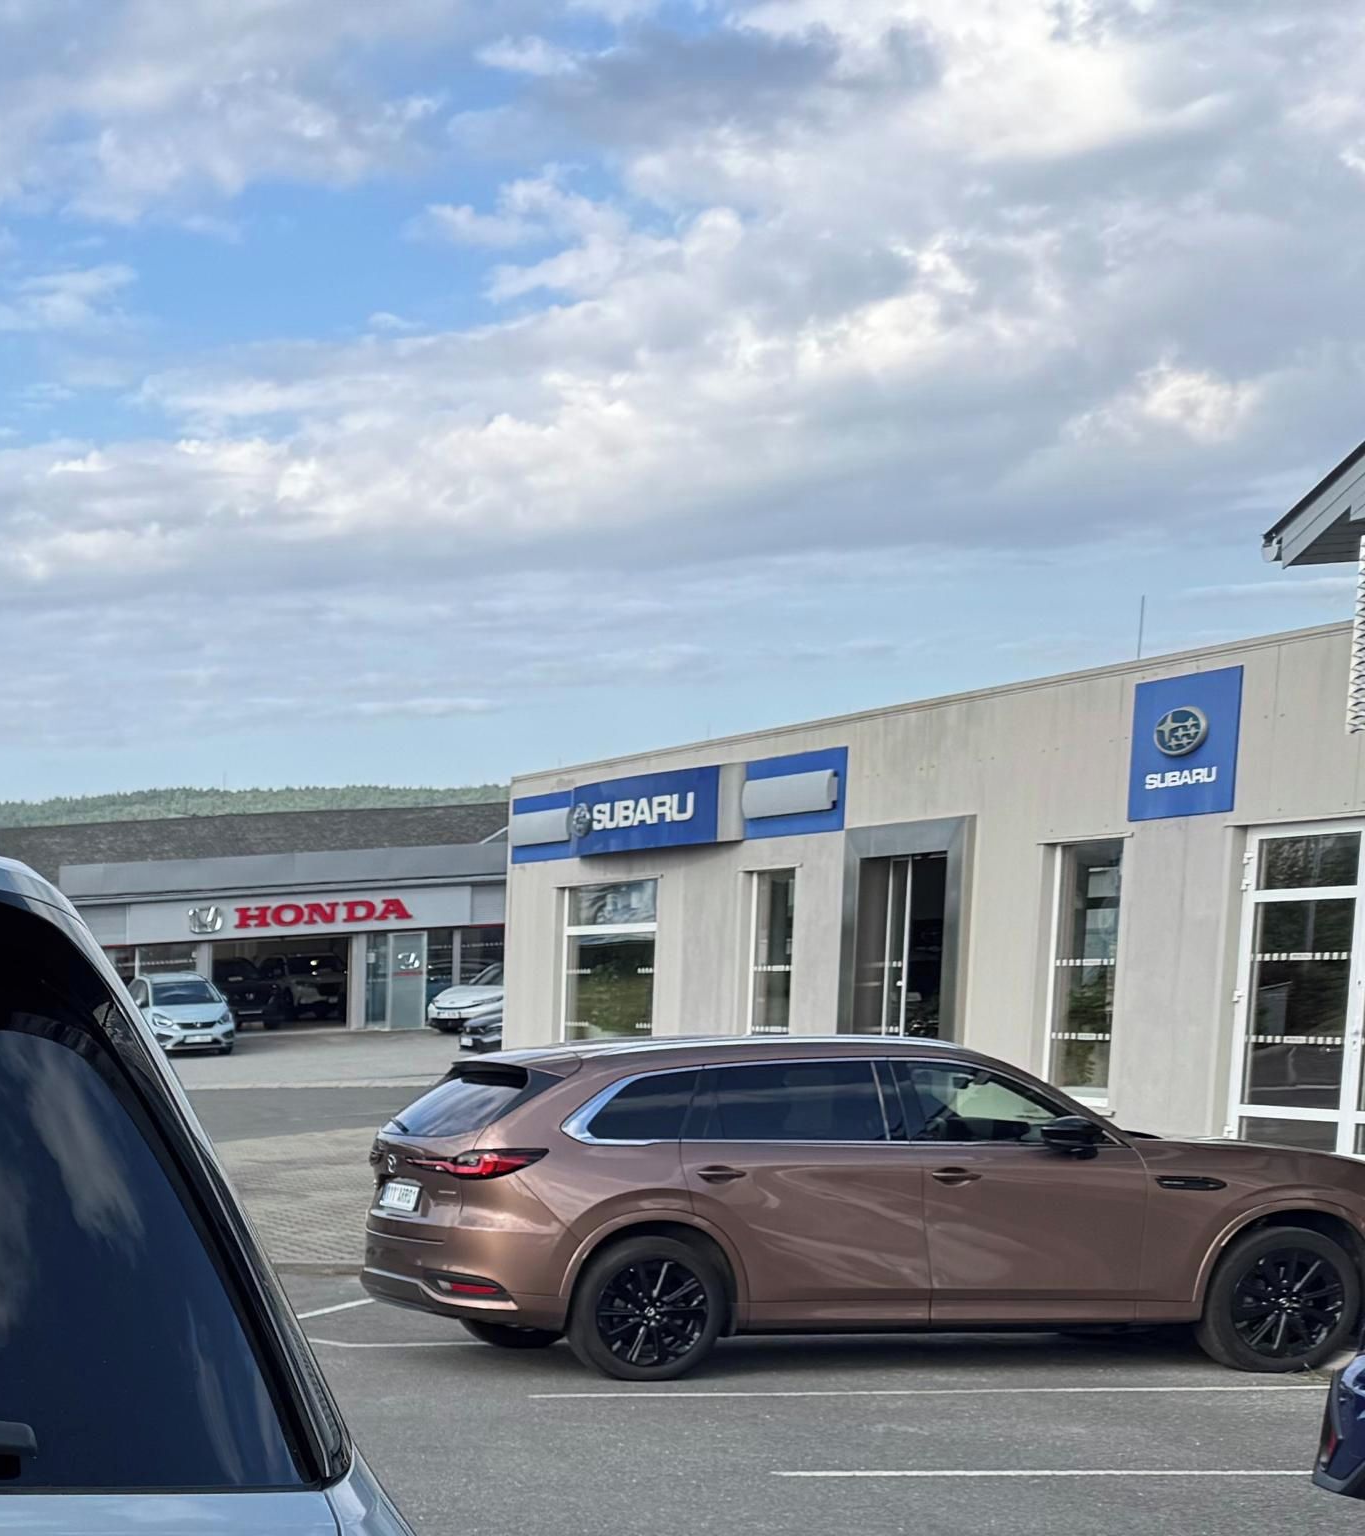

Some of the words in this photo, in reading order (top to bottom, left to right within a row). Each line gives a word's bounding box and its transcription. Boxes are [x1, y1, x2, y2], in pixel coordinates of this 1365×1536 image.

[1145, 766, 1217, 790] SUBARU
[592, 791, 695, 831] SUBARU
[234, 898, 412, 930] HONDA
